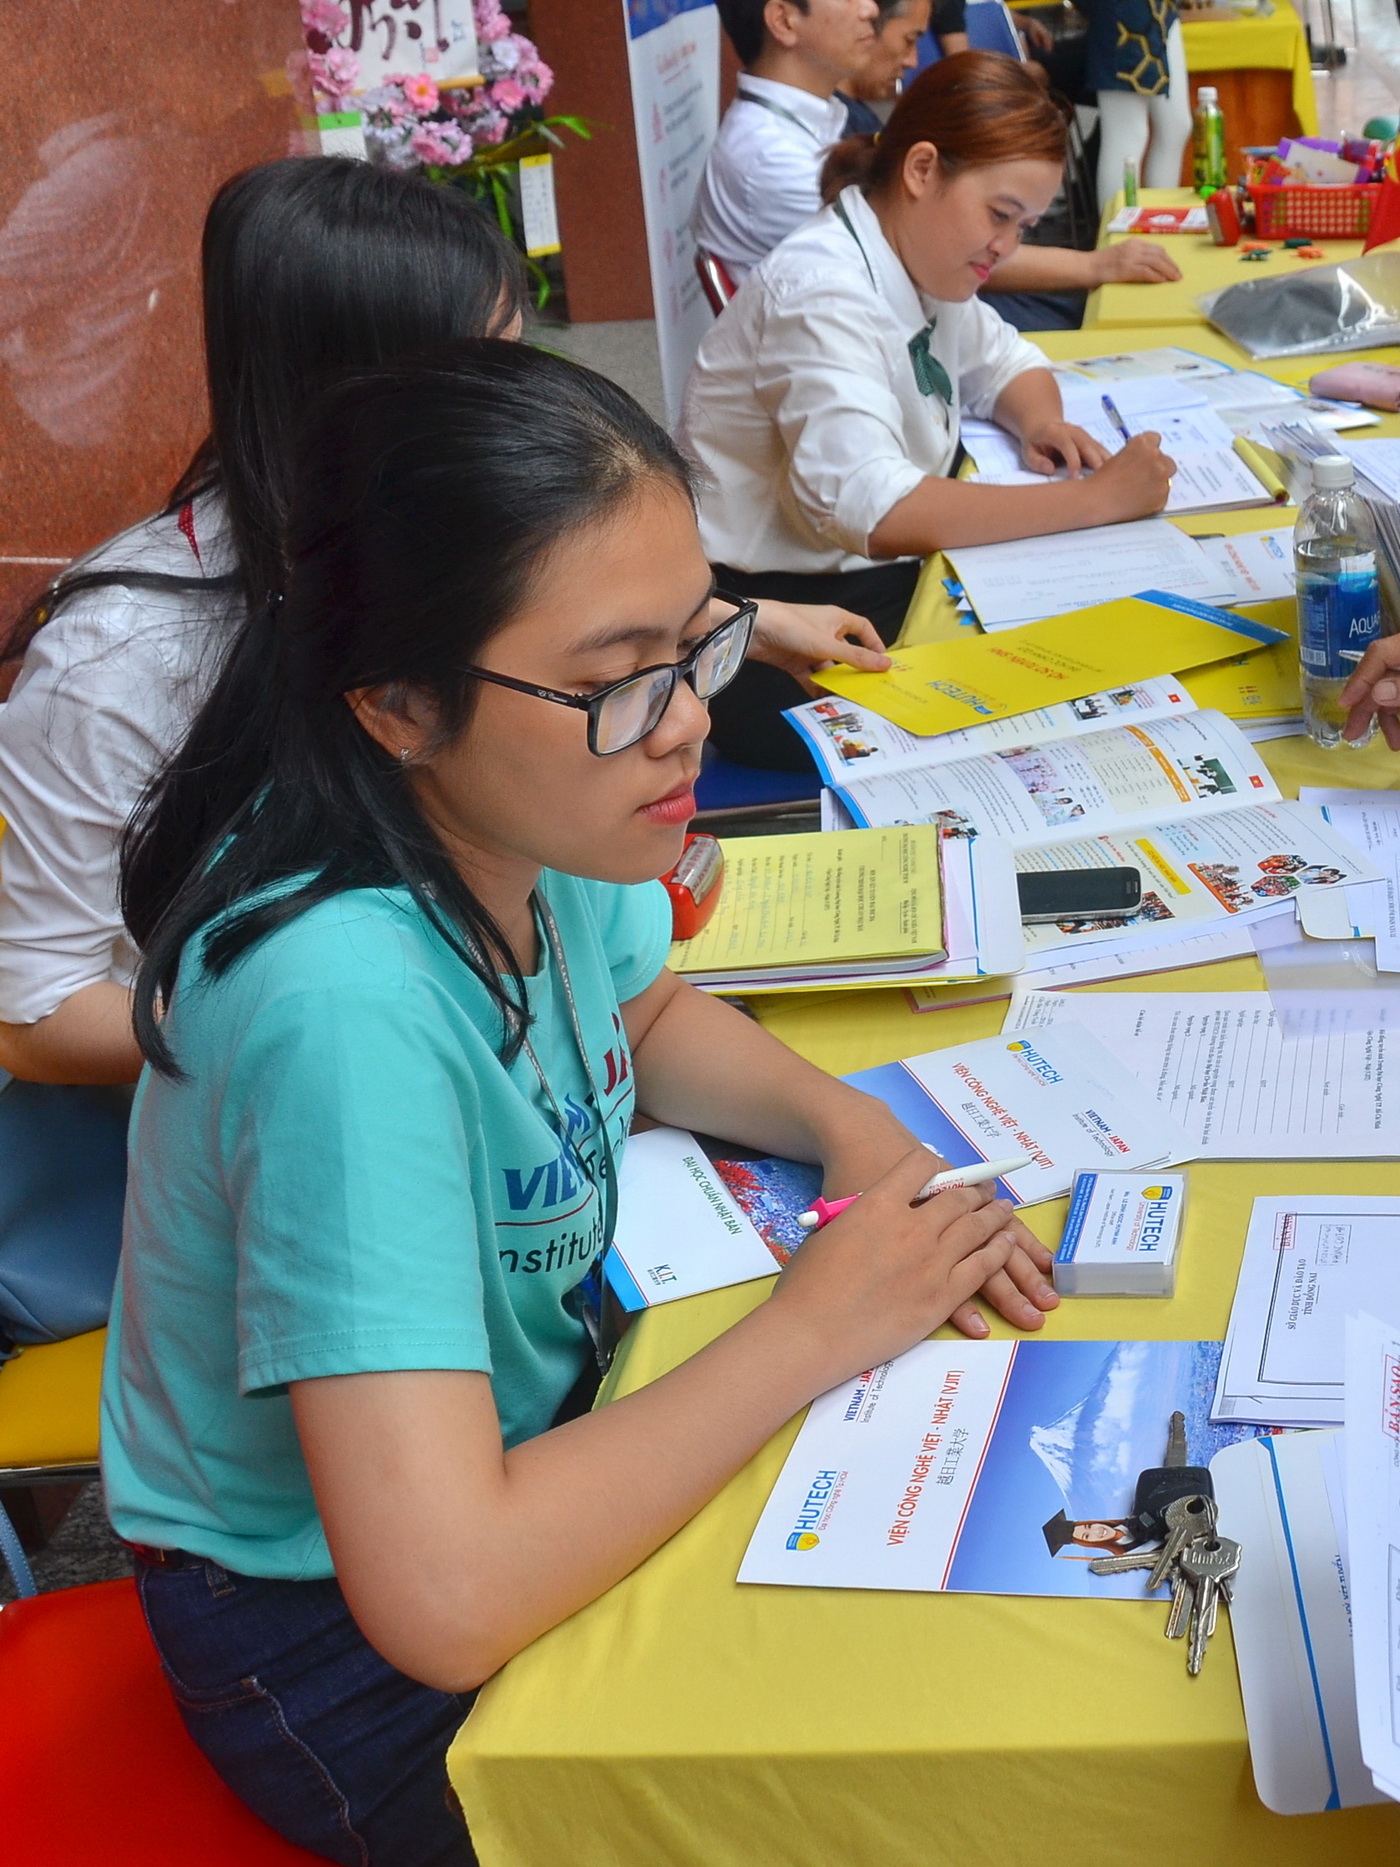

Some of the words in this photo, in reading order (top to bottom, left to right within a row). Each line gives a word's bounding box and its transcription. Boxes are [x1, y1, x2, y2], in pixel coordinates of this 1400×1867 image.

[925, 679, 986, 706] HUTECH
[1021, 1048, 1064, 1084] HUTECH
[952, 1062, 970, 1078] VIỆN
[964, 1077, 989, 1098] CÔNG
[981, 1097, 1008, 1117] NGHỆ
[1000, 1114, 1019, 1129] VIỆT
[1013, 1131, 1039, 1151] NHẬT
[1028, 1150, 1055, 1170] (VJIT)
[1072, 1113, 1088, 1128] Institute
[1089, 1133, 1115, 1157] Technology
[1085, 1109, 1112, 1133] VIETNAM
[1108, 1135, 1130, 1153] JAPAN
[682, 1156, 698, 1168] ĐẠI
[690, 1167, 707, 1181] HỌC
[699, 1180, 723, 1203] CHUẨN
[711, 1201, 733, 1220] NHẬT
[724, 1219, 743, 1235] BẢN
[1133, 1202, 1147, 1222] University
[1126, 1228, 1140, 1251] Technology
[1139, 1202, 1168, 1251] HUTECH
[1293, 1271, 1305, 1283] ĐÀO
[1296, 1259, 1306, 1270] TẠO
[1291, 1284, 1303, 1292] VÀ
[1308, 1273, 1317, 1283] NAI
[1290, 1293, 1302, 1306] DỤC
[1303, 1284, 1316, 1301] ĐỒNG
[1286, 1306, 1299, 1320] GIÁO
[1302, 1302, 1313, 1315] TỈNH
[1285, 1320, 1297, 1330] SỞ
[860, 1402, 877, 1423] Institute
[872, 1360, 894, 1392] Technology
[940, 1370, 965, 1395] (VJIT)
[842, 1389, 866, 1421] VIETNAM
[930, 1397, 955, 1424] NHẬT
[1384, 1396, 1400, 1432] BẢN
[920, 1432, 943, 1452] VIỆT
[908, 1454, 936, 1482] NGHỆ
[794, 1470, 837, 1530] HUTECH
[896, 1486, 922, 1518] CÔNG
[886, 1520, 910, 1546] VIỆN
